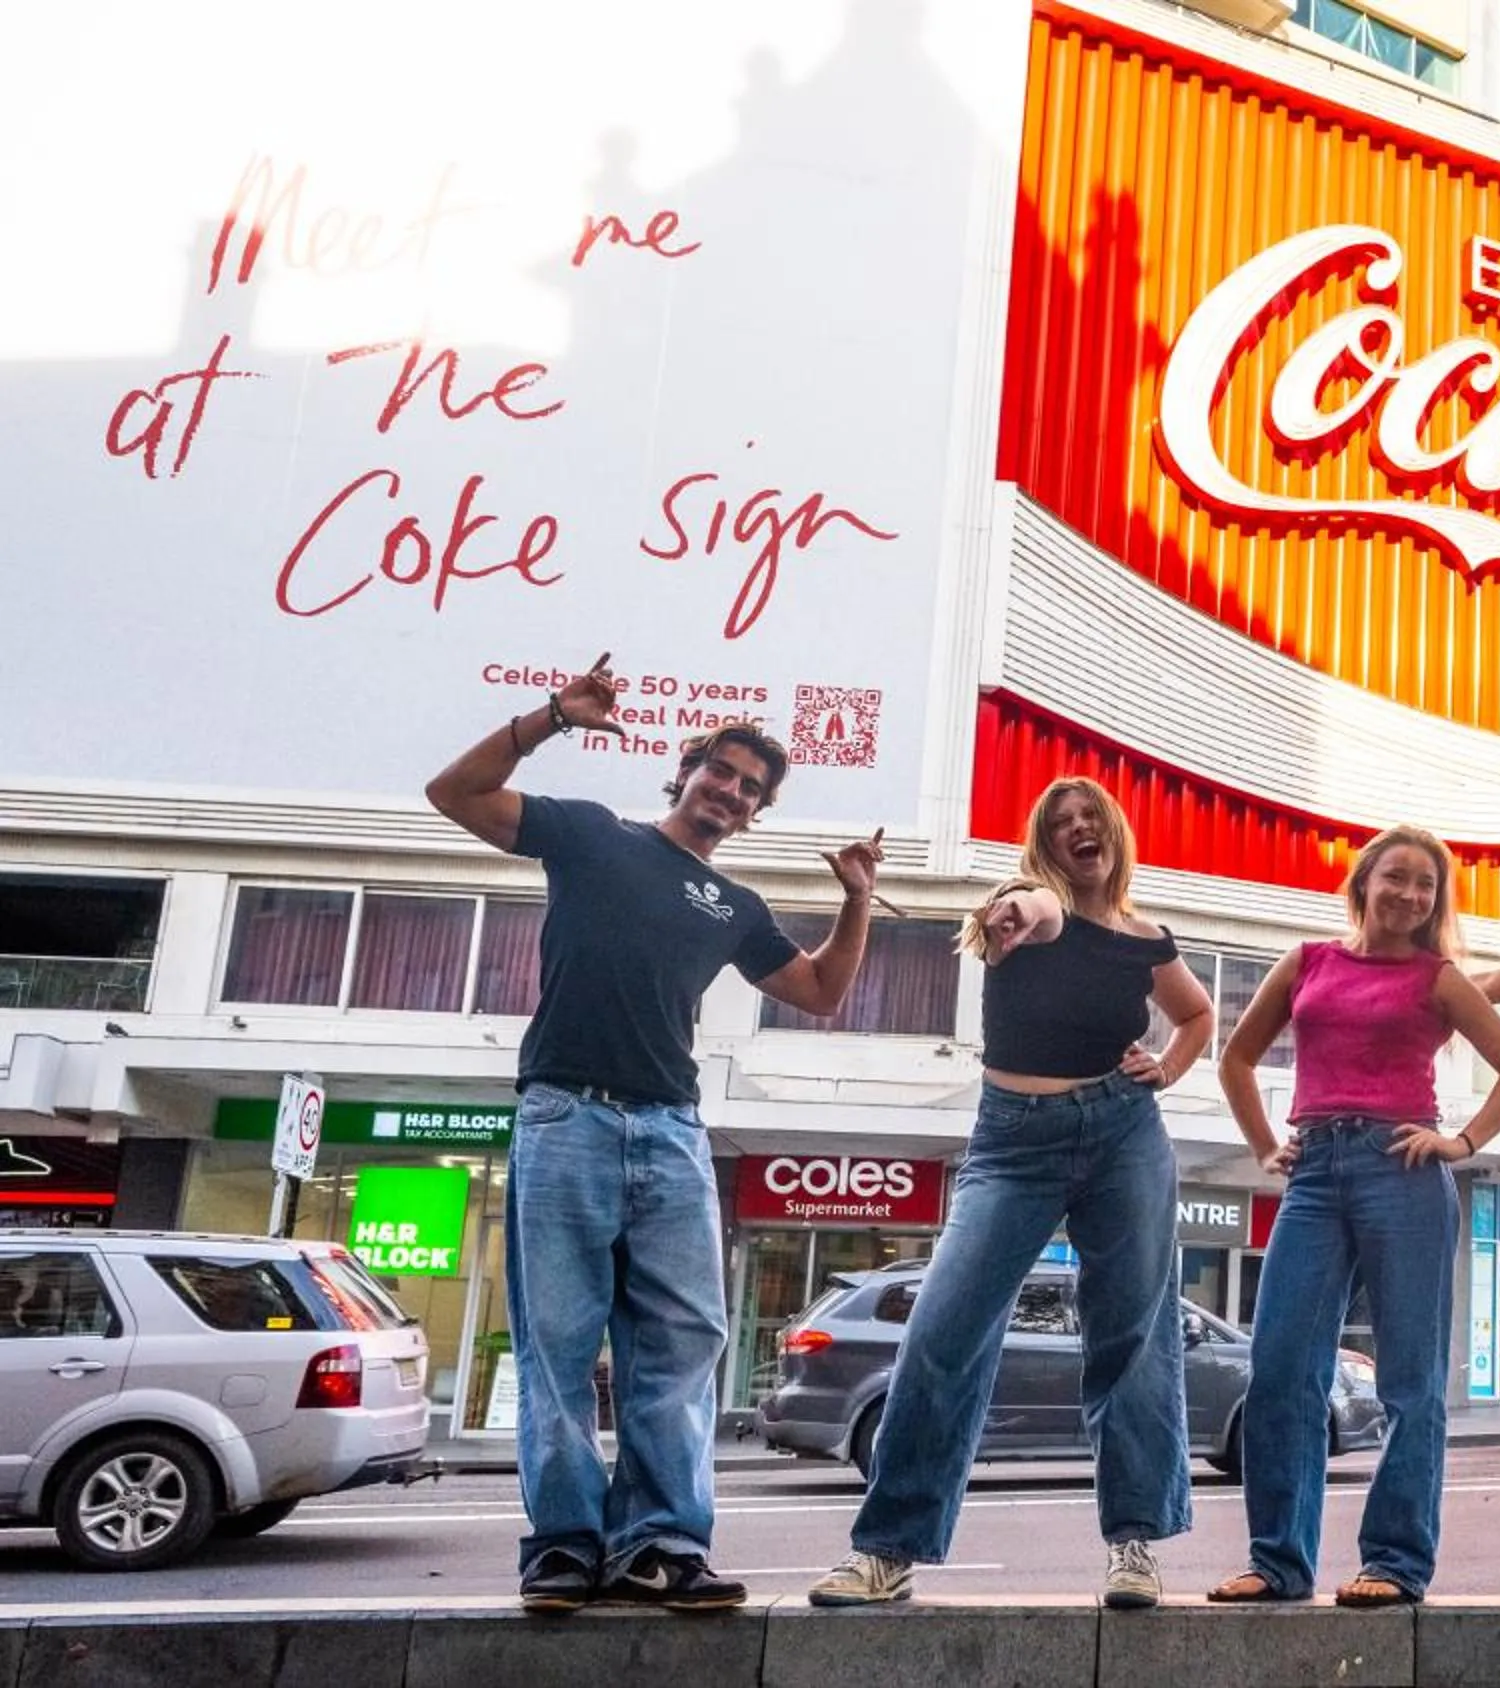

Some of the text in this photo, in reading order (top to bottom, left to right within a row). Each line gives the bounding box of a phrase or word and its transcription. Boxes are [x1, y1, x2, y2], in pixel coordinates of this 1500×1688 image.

[569, 208, 703, 269] me
[104, 334, 268, 481] at
[275, 438, 901, 641] Coke sign
[482, 663, 768, 705] Celebe 50 years
[583, 730, 609, 751] in
[619, 734, 669, 755] the
[404, 1113, 512, 1131] H&R BLOCK
[404, 1129, 493, 1141] TAX ACCOUNTANTS
[764, 1156, 915, 1198] coles
[784, 1199, 892, 1218] Supermarket
[355, 1220, 419, 1245] H&R
[353, 1245, 450, 1269] BLOCK
